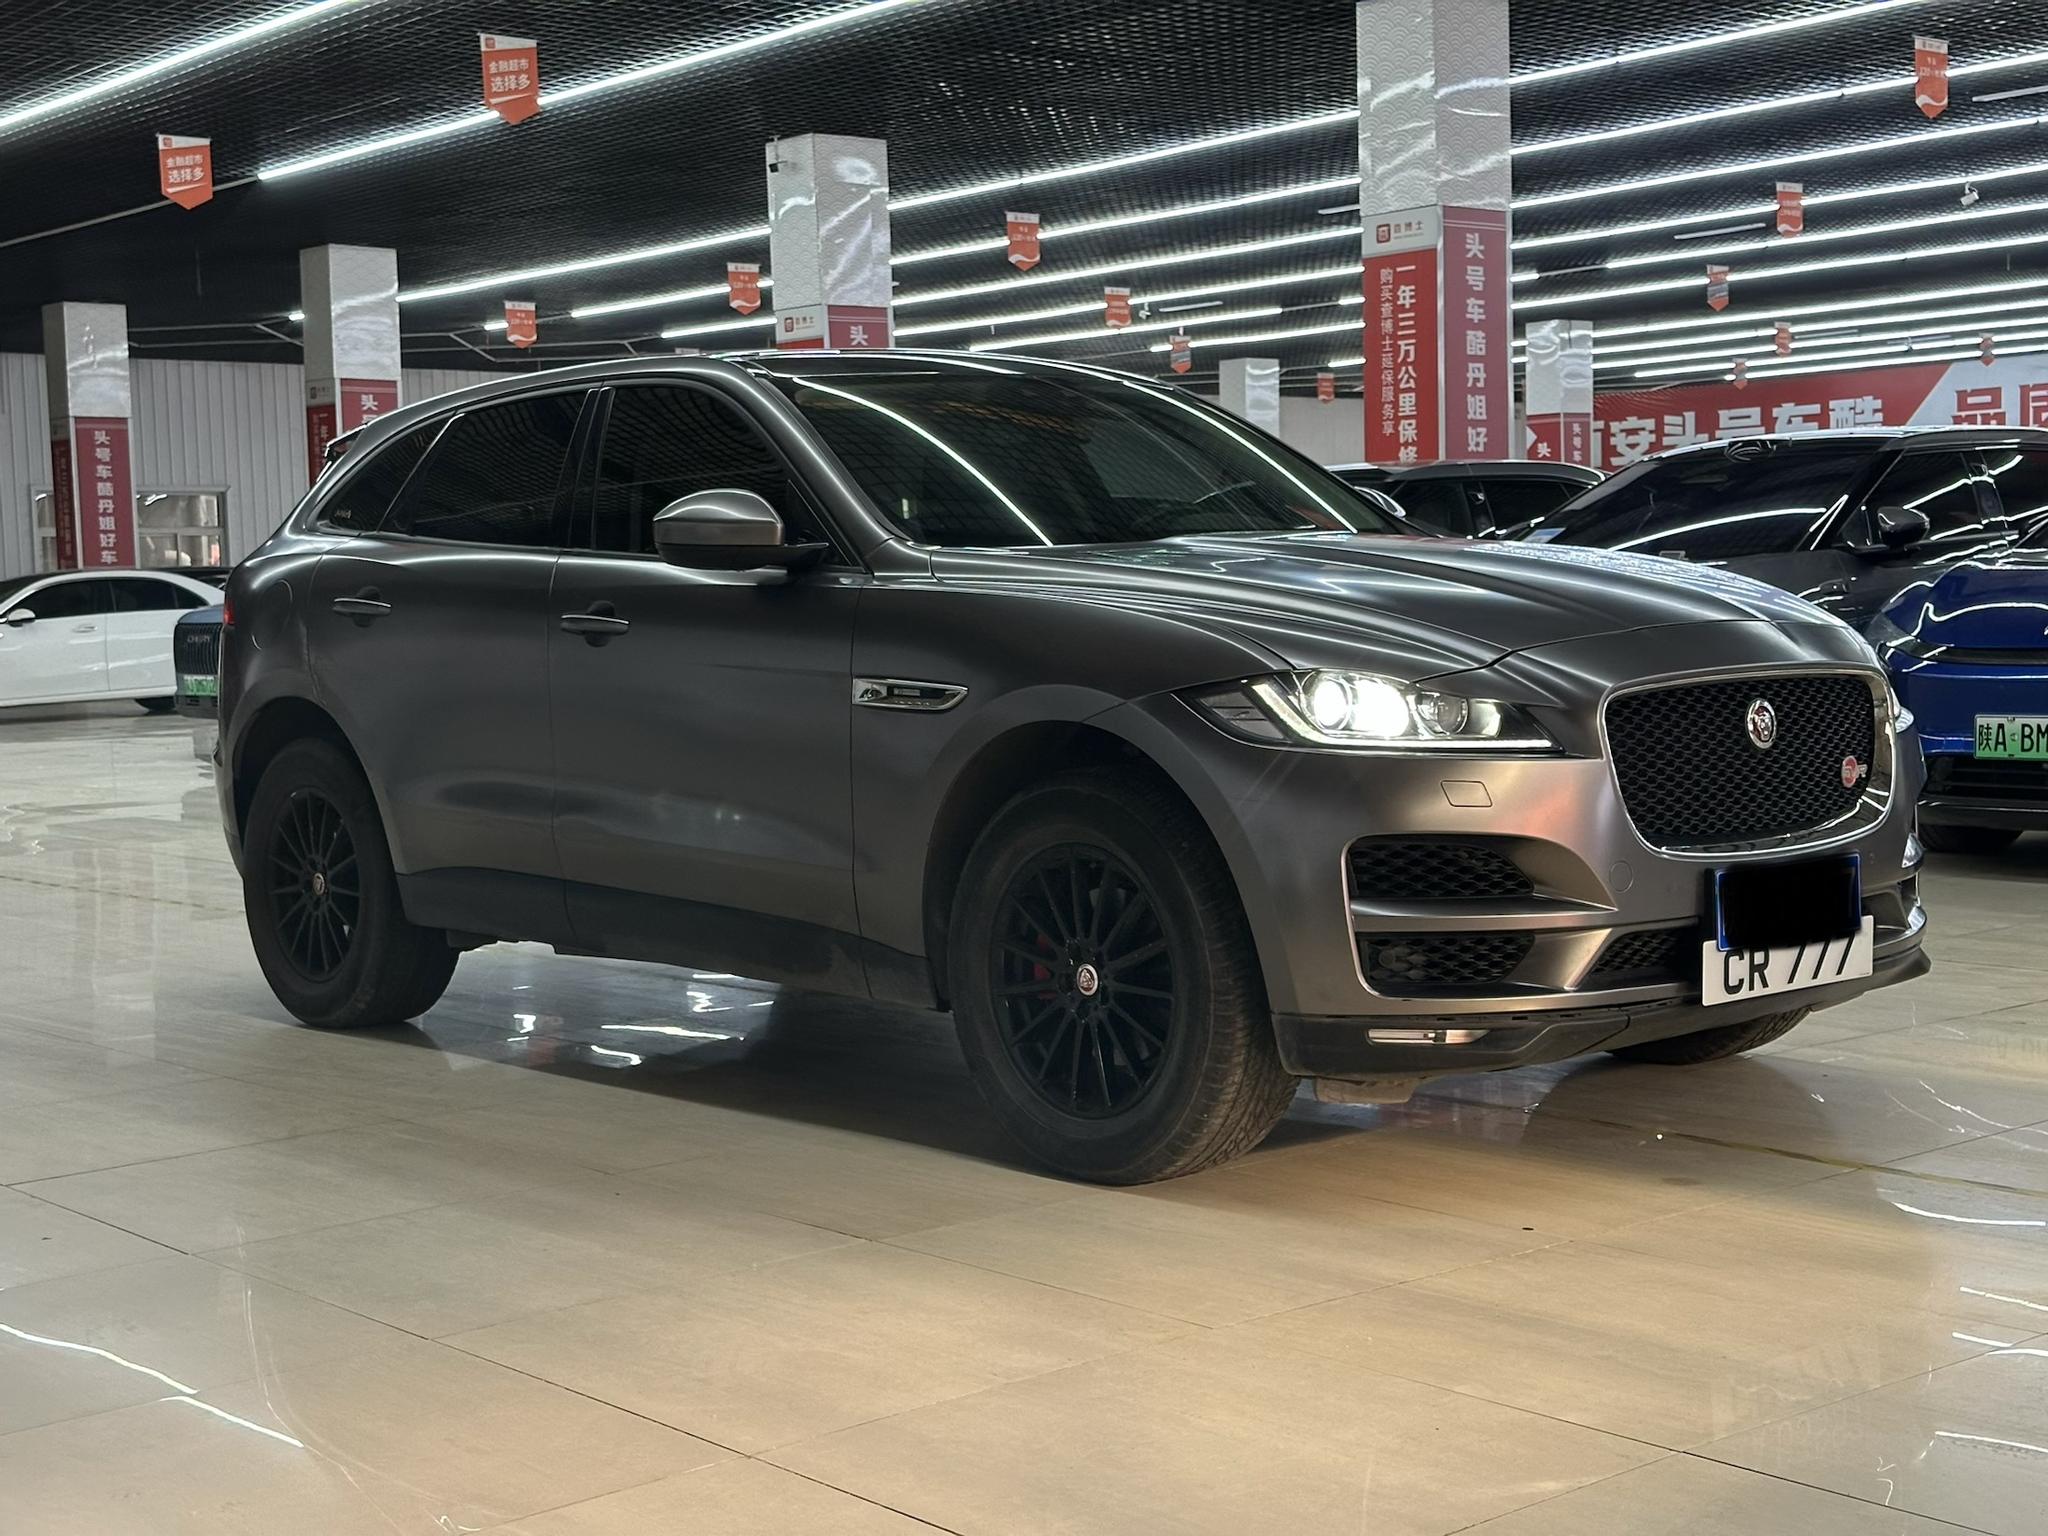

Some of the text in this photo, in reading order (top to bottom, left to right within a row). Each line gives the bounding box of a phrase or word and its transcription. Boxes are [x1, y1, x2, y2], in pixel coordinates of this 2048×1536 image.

[491, 74, 531, 93] 选择多
[168, 167, 204, 184] 选择多
[850, 325, 869, 346] 头
[1465, 233, 1488, 453] 头号车酷丹姐好
[1396, 265, 1418, 464] 一年三万公里保修
[1537, 442, 1552, 458] 头
[94, 430, 118, 565] 头号车酷丹姐好车
[1723, 947, 1769, 995] CR
